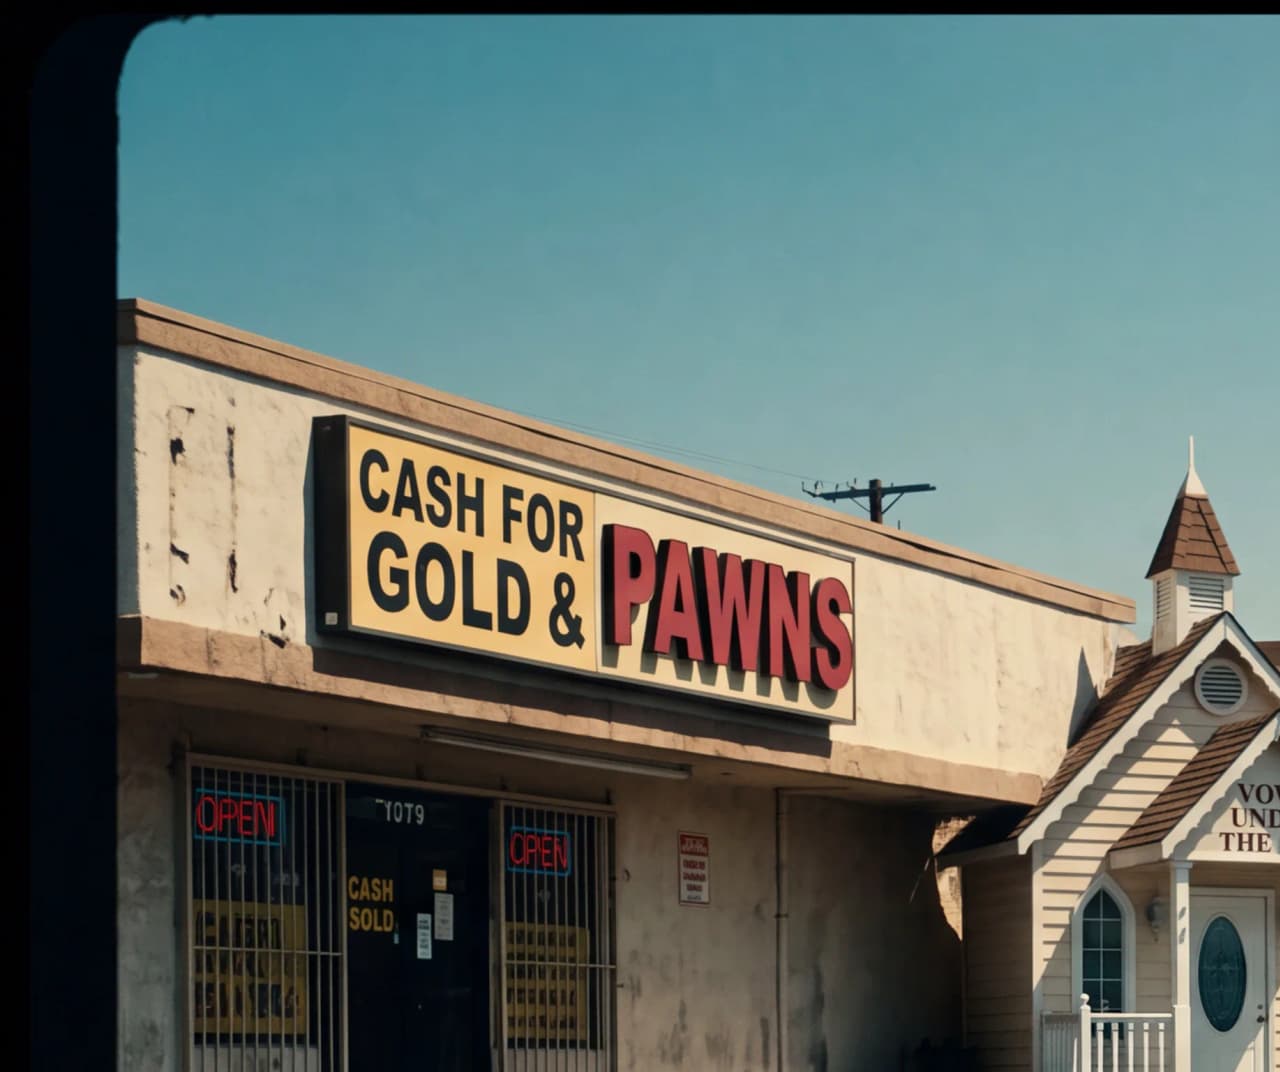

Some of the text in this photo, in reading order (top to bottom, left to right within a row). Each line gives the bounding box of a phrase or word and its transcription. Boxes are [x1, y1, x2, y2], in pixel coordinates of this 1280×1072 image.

[359, 448, 586, 562] CASH FOR
[367, 531, 586, 650] GOLD &
[604, 522, 854, 692] PAWNS
[195, 795, 277, 838] OPEN
[509, 831, 569, 869] OPEN
[1218, 832, 1273, 853] THE
[347, 875, 394, 902] CASH
[349, 906, 394, 932] SOLD
